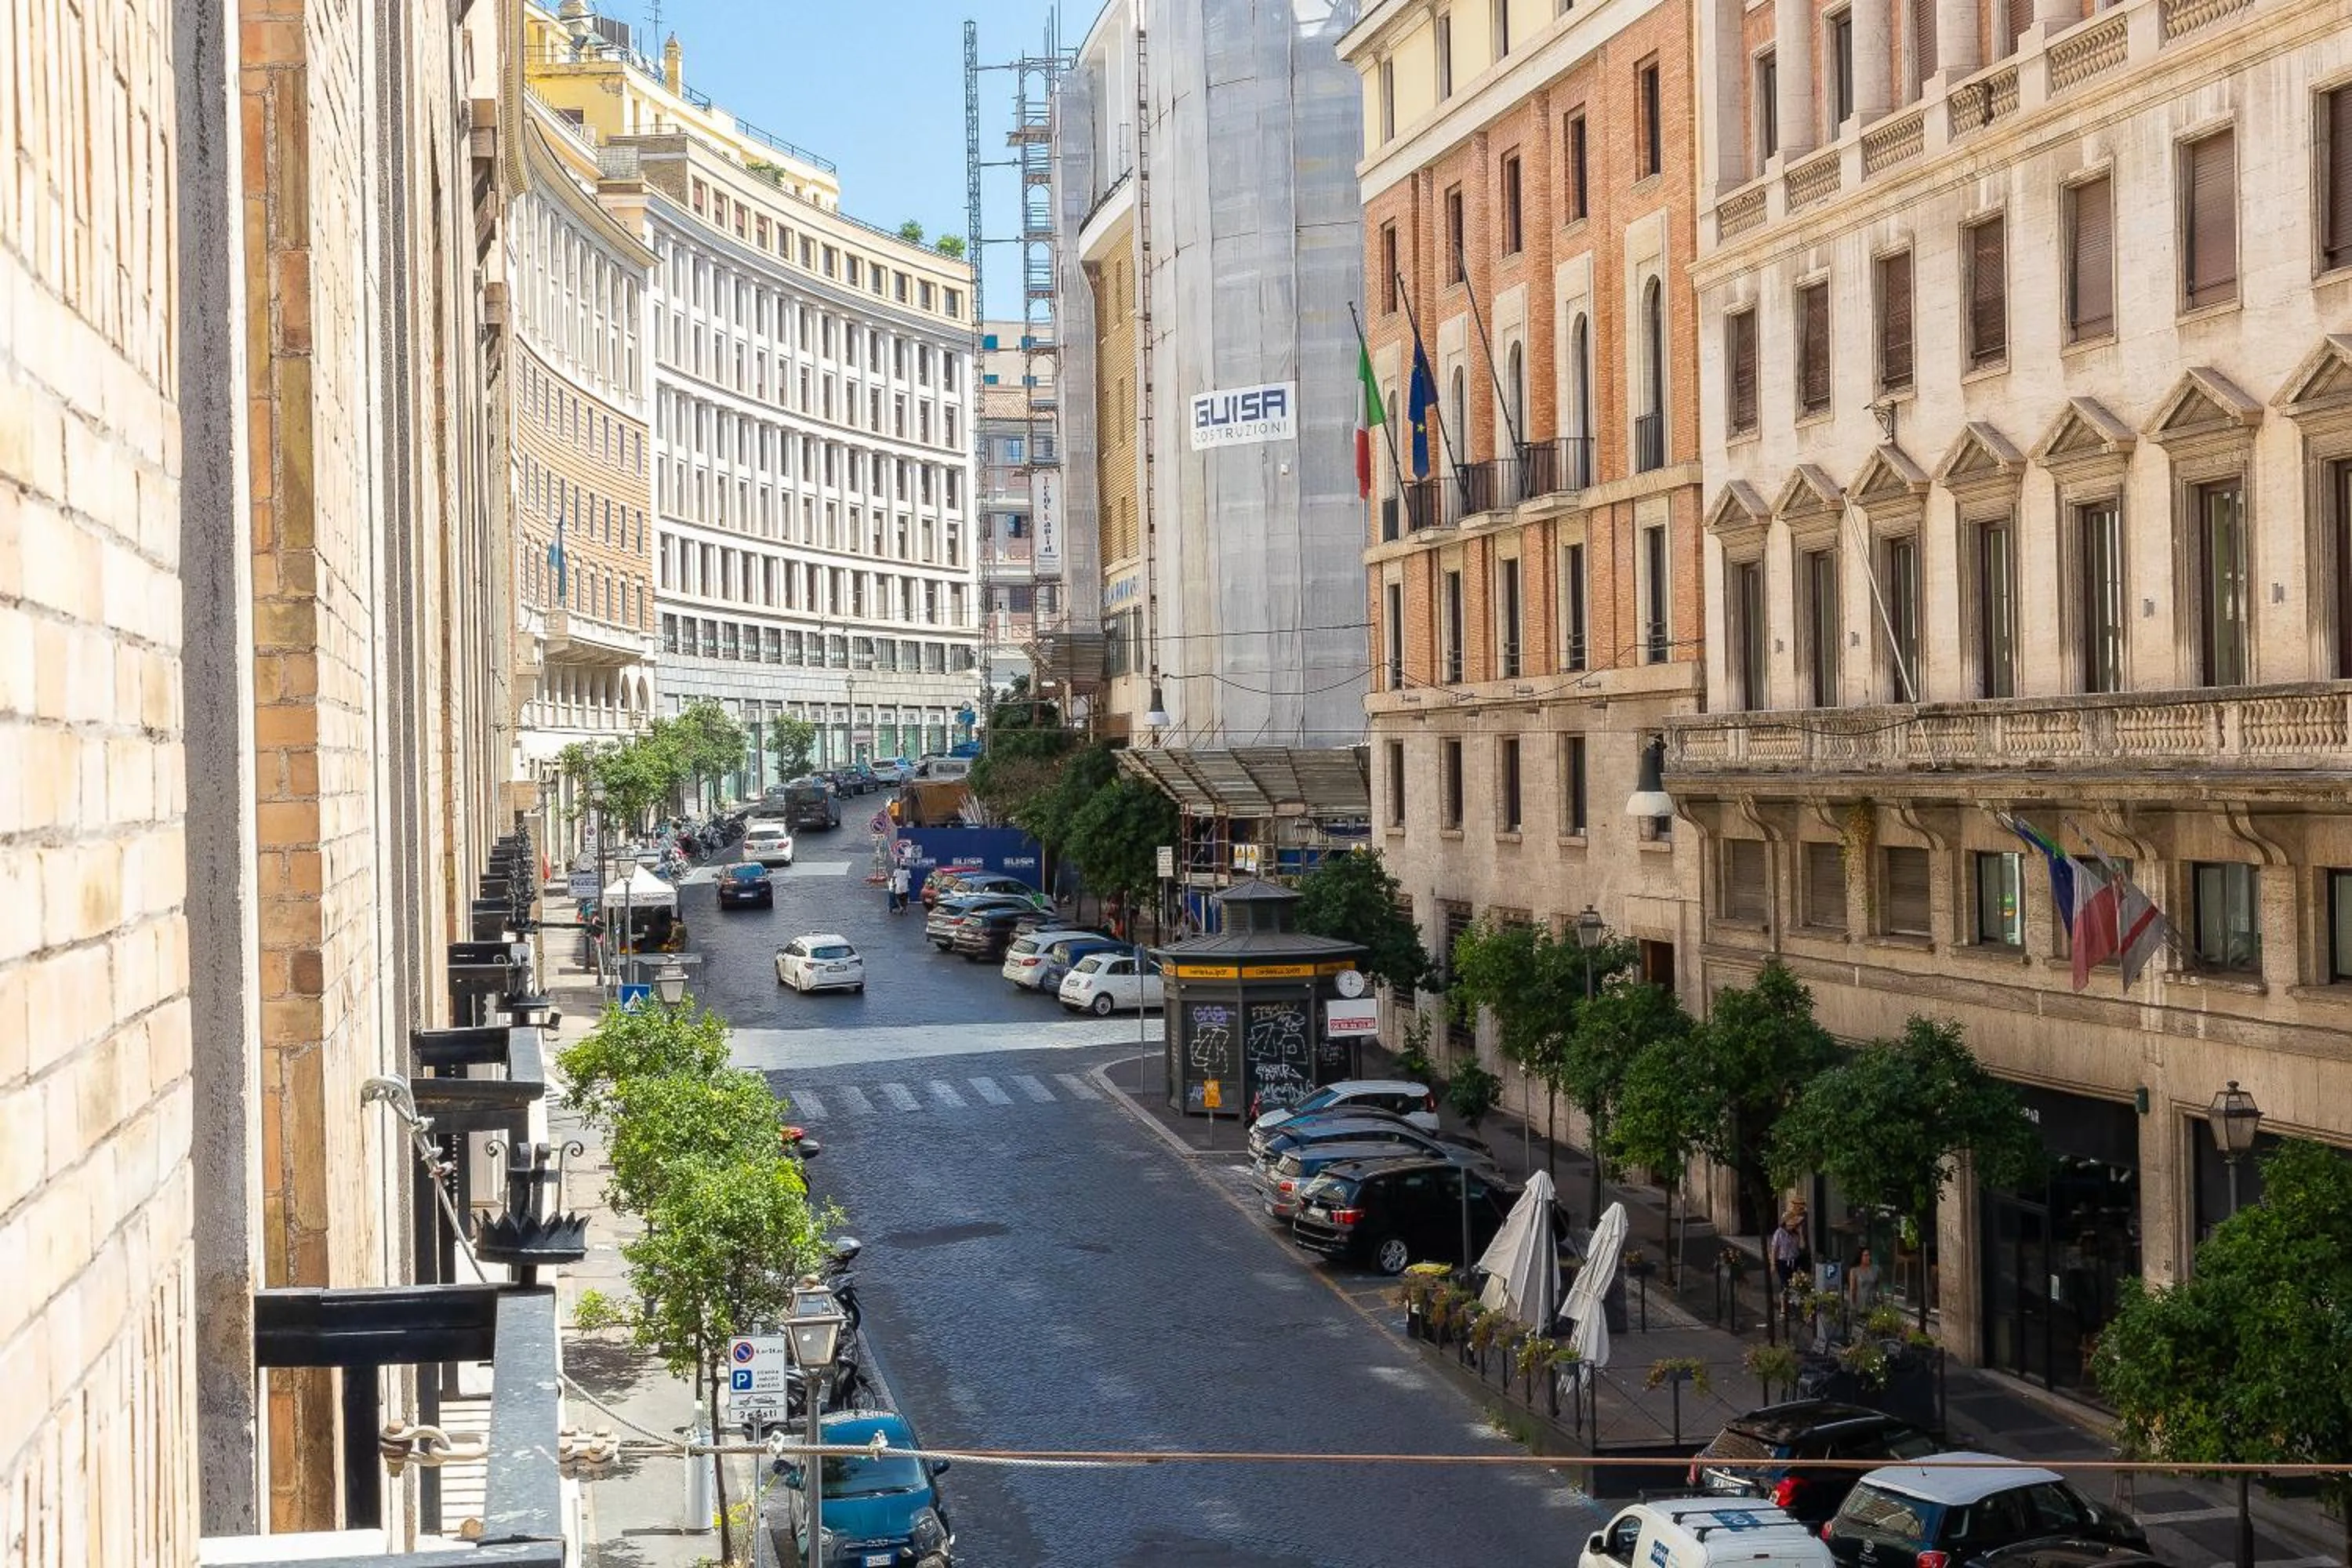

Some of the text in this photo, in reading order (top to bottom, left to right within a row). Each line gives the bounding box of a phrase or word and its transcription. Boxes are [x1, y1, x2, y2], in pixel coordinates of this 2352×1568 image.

[1194, 388, 1287, 428] GUISA
[736, 1373, 747, 1387] P
[748, 1410, 777, 1418] sti
